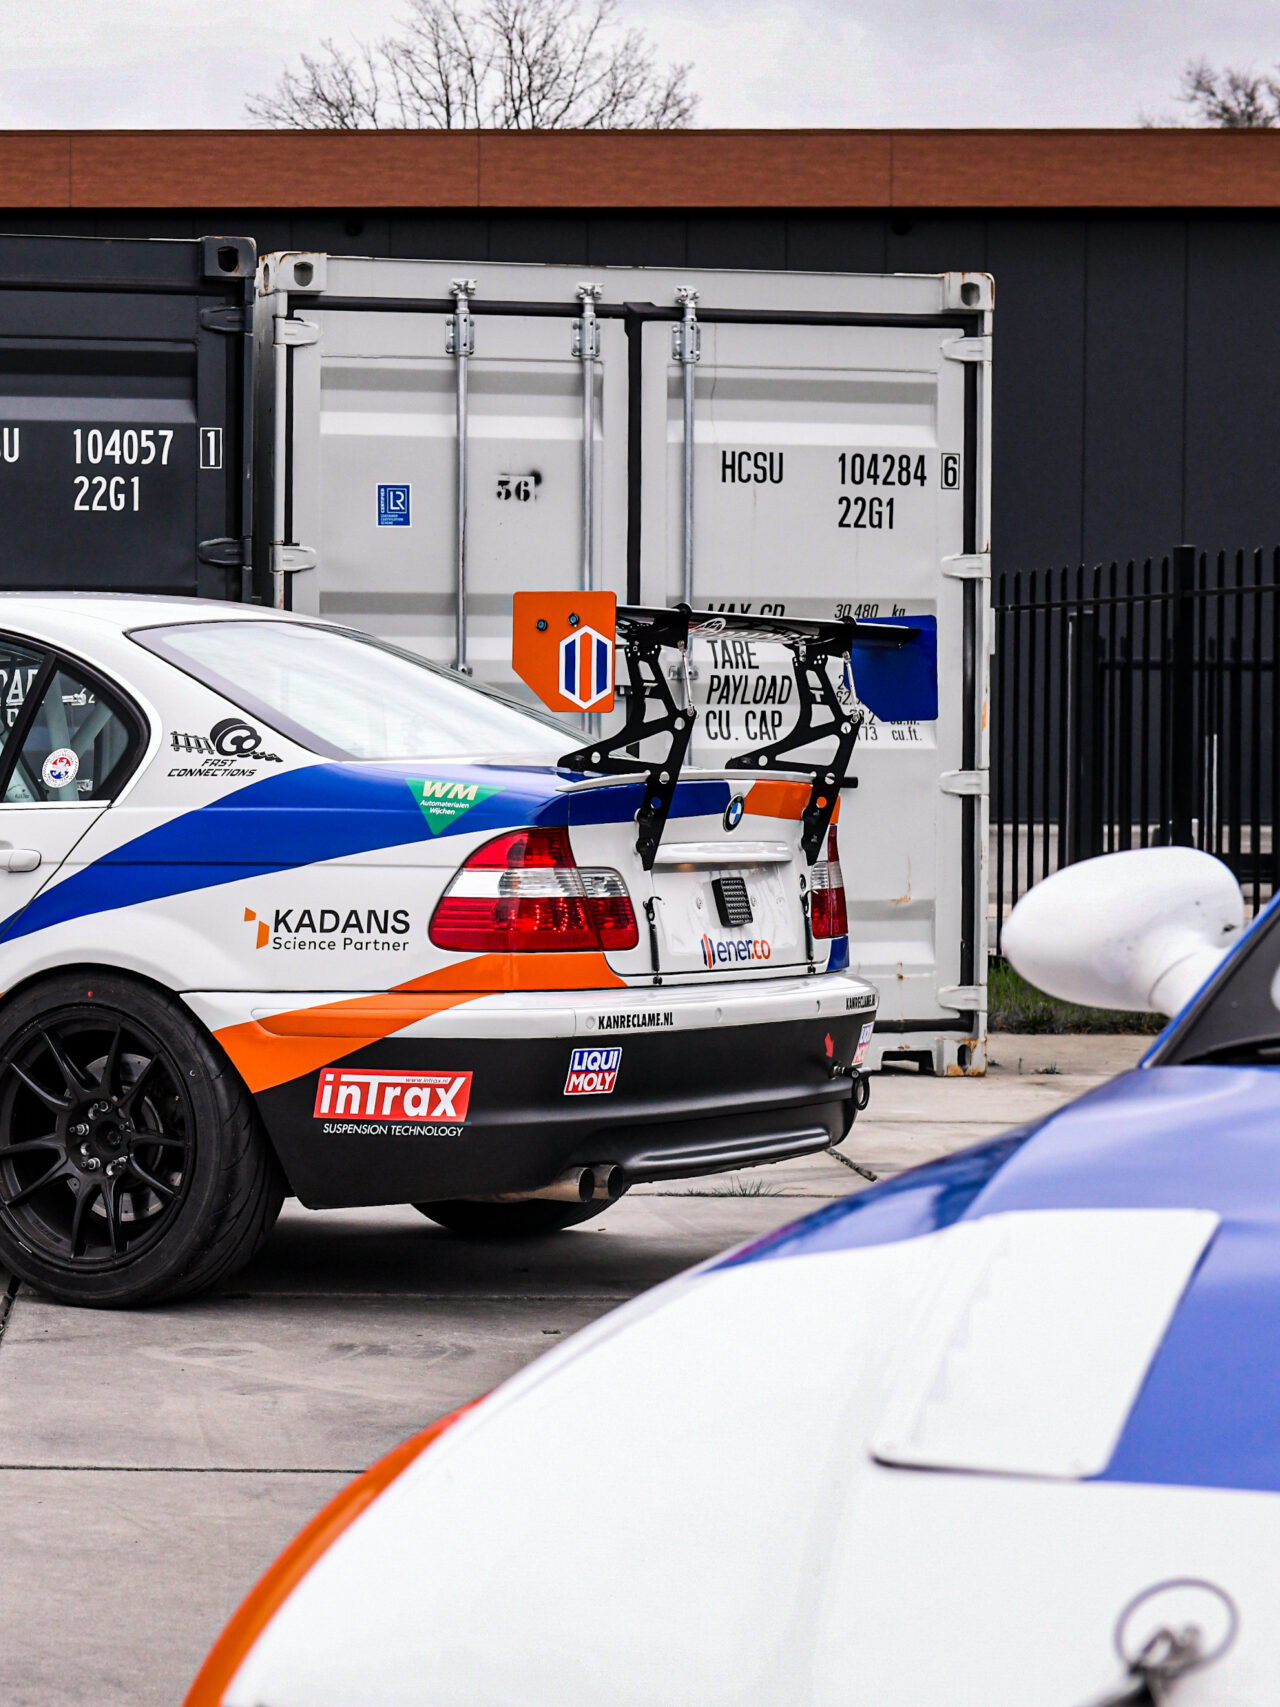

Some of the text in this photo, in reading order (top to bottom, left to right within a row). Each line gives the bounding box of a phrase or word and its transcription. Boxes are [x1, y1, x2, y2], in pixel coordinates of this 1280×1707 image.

[73, 429, 174, 465] 104057
[721, 451, 957, 487] HCSU 104284 6
[73, 476, 139, 511] 22G1
[838, 497, 894, 530] 22G1
[706, 640, 760, 670] TARE
[705, 674, 793, 705] PAYLOAD
[745, 710, 783, 741] CAP
[891, 725, 923, 741] cu.ft.
[167, 768, 258, 777] CONNECTIONS
[201, 758, 238, 767] FAST
[422, 780, 479, 801] WM
[420, 800, 470, 809] Automaterialen
[429, 807, 456, 815] Wijchen
[273, 909, 410, 935] KADANS
[272, 936, 409, 951] Science Partner
[716, 938, 771, 963] ener.co
[597, 1011, 674, 1030] KANRECLAME.NL
[572, 1050, 619, 1072] LIQUI
[567, 1071, 616, 1092] MOLY
[323, 1123, 464, 1137] SUSPENSION TECHNOLOGY
